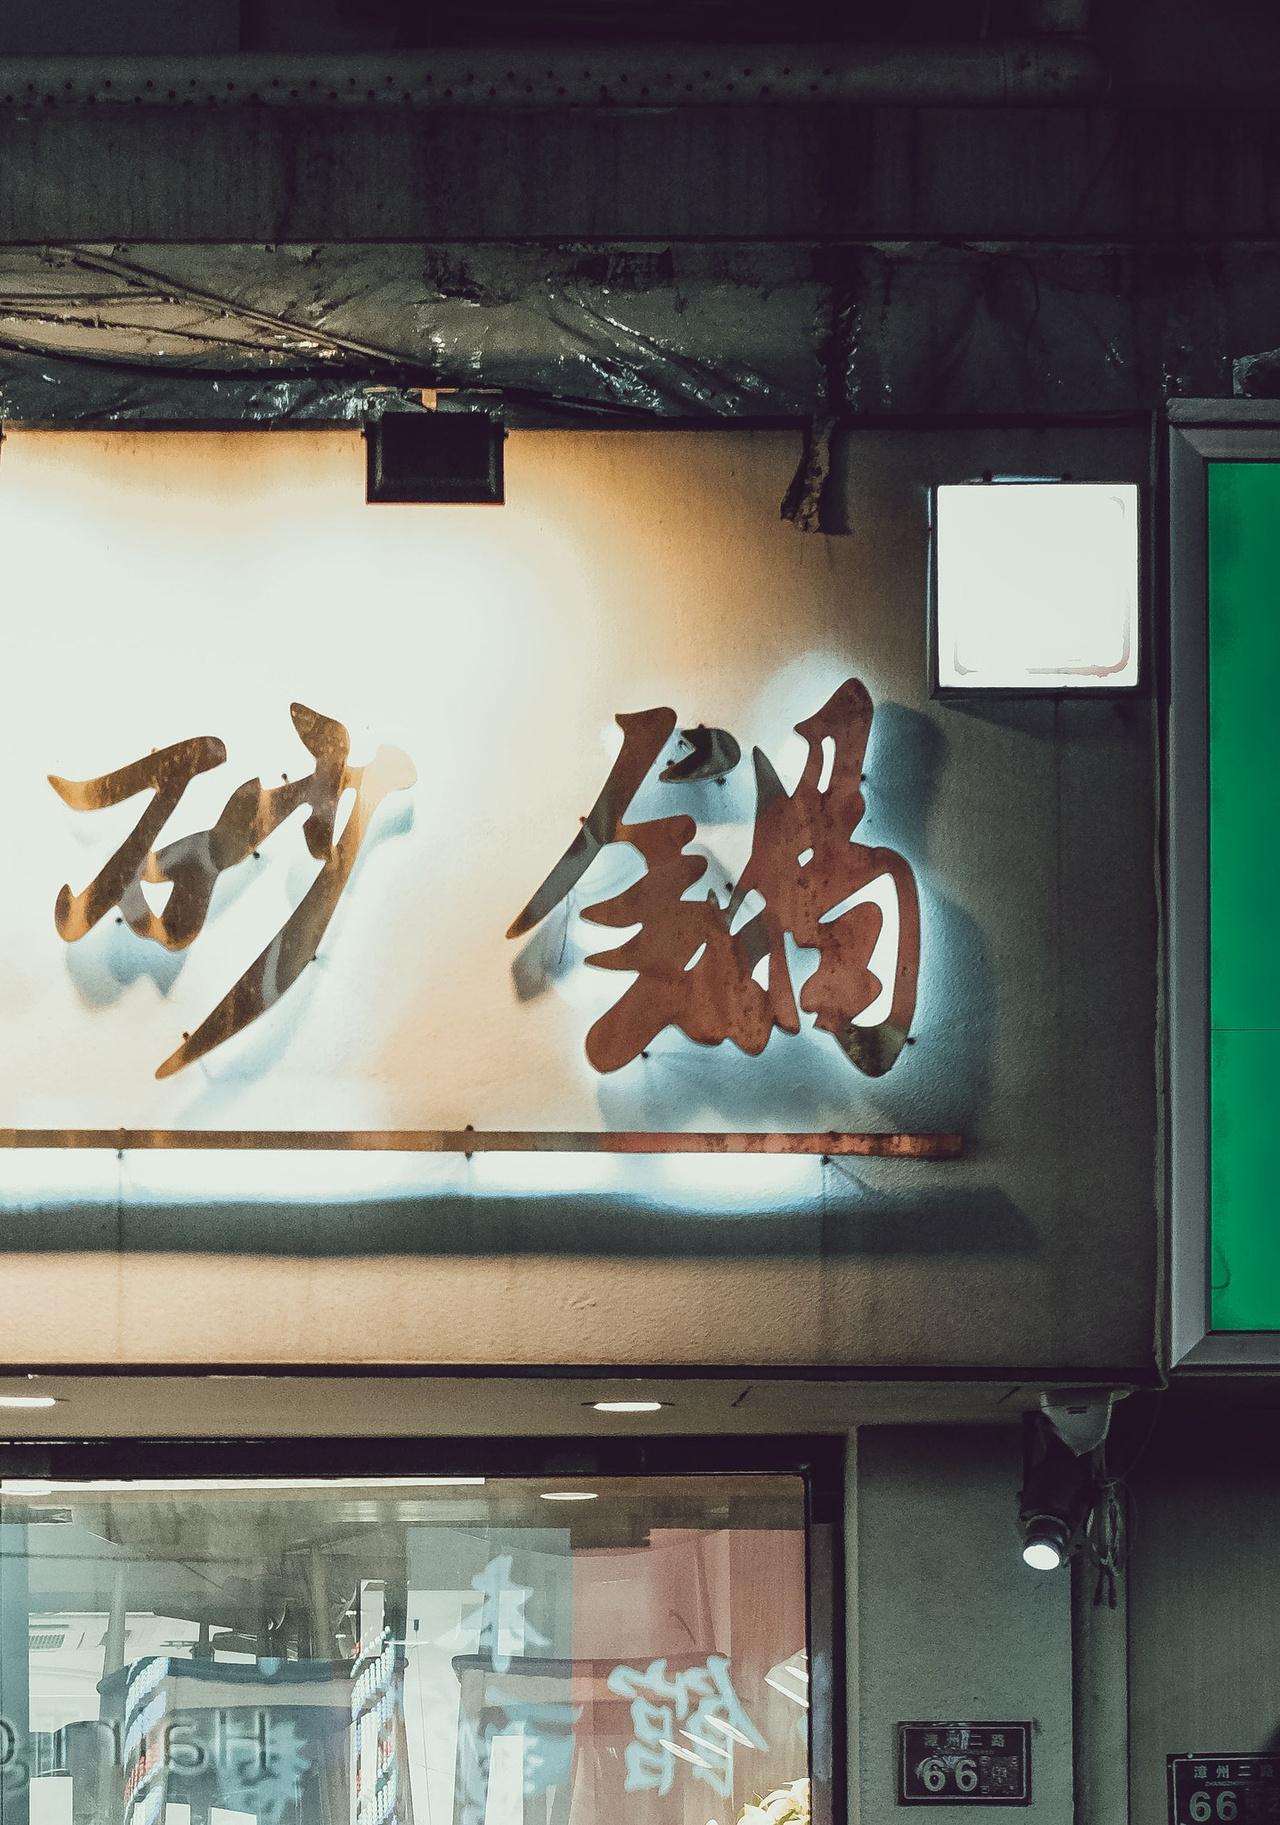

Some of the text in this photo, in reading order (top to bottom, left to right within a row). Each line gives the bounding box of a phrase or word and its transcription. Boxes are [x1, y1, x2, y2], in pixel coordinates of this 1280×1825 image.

[922, 1758, 979, 1792] 66
[1193, 1765, 1274, 1780] 漳州二路
[1189, 1790, 1238, 1822] 66
